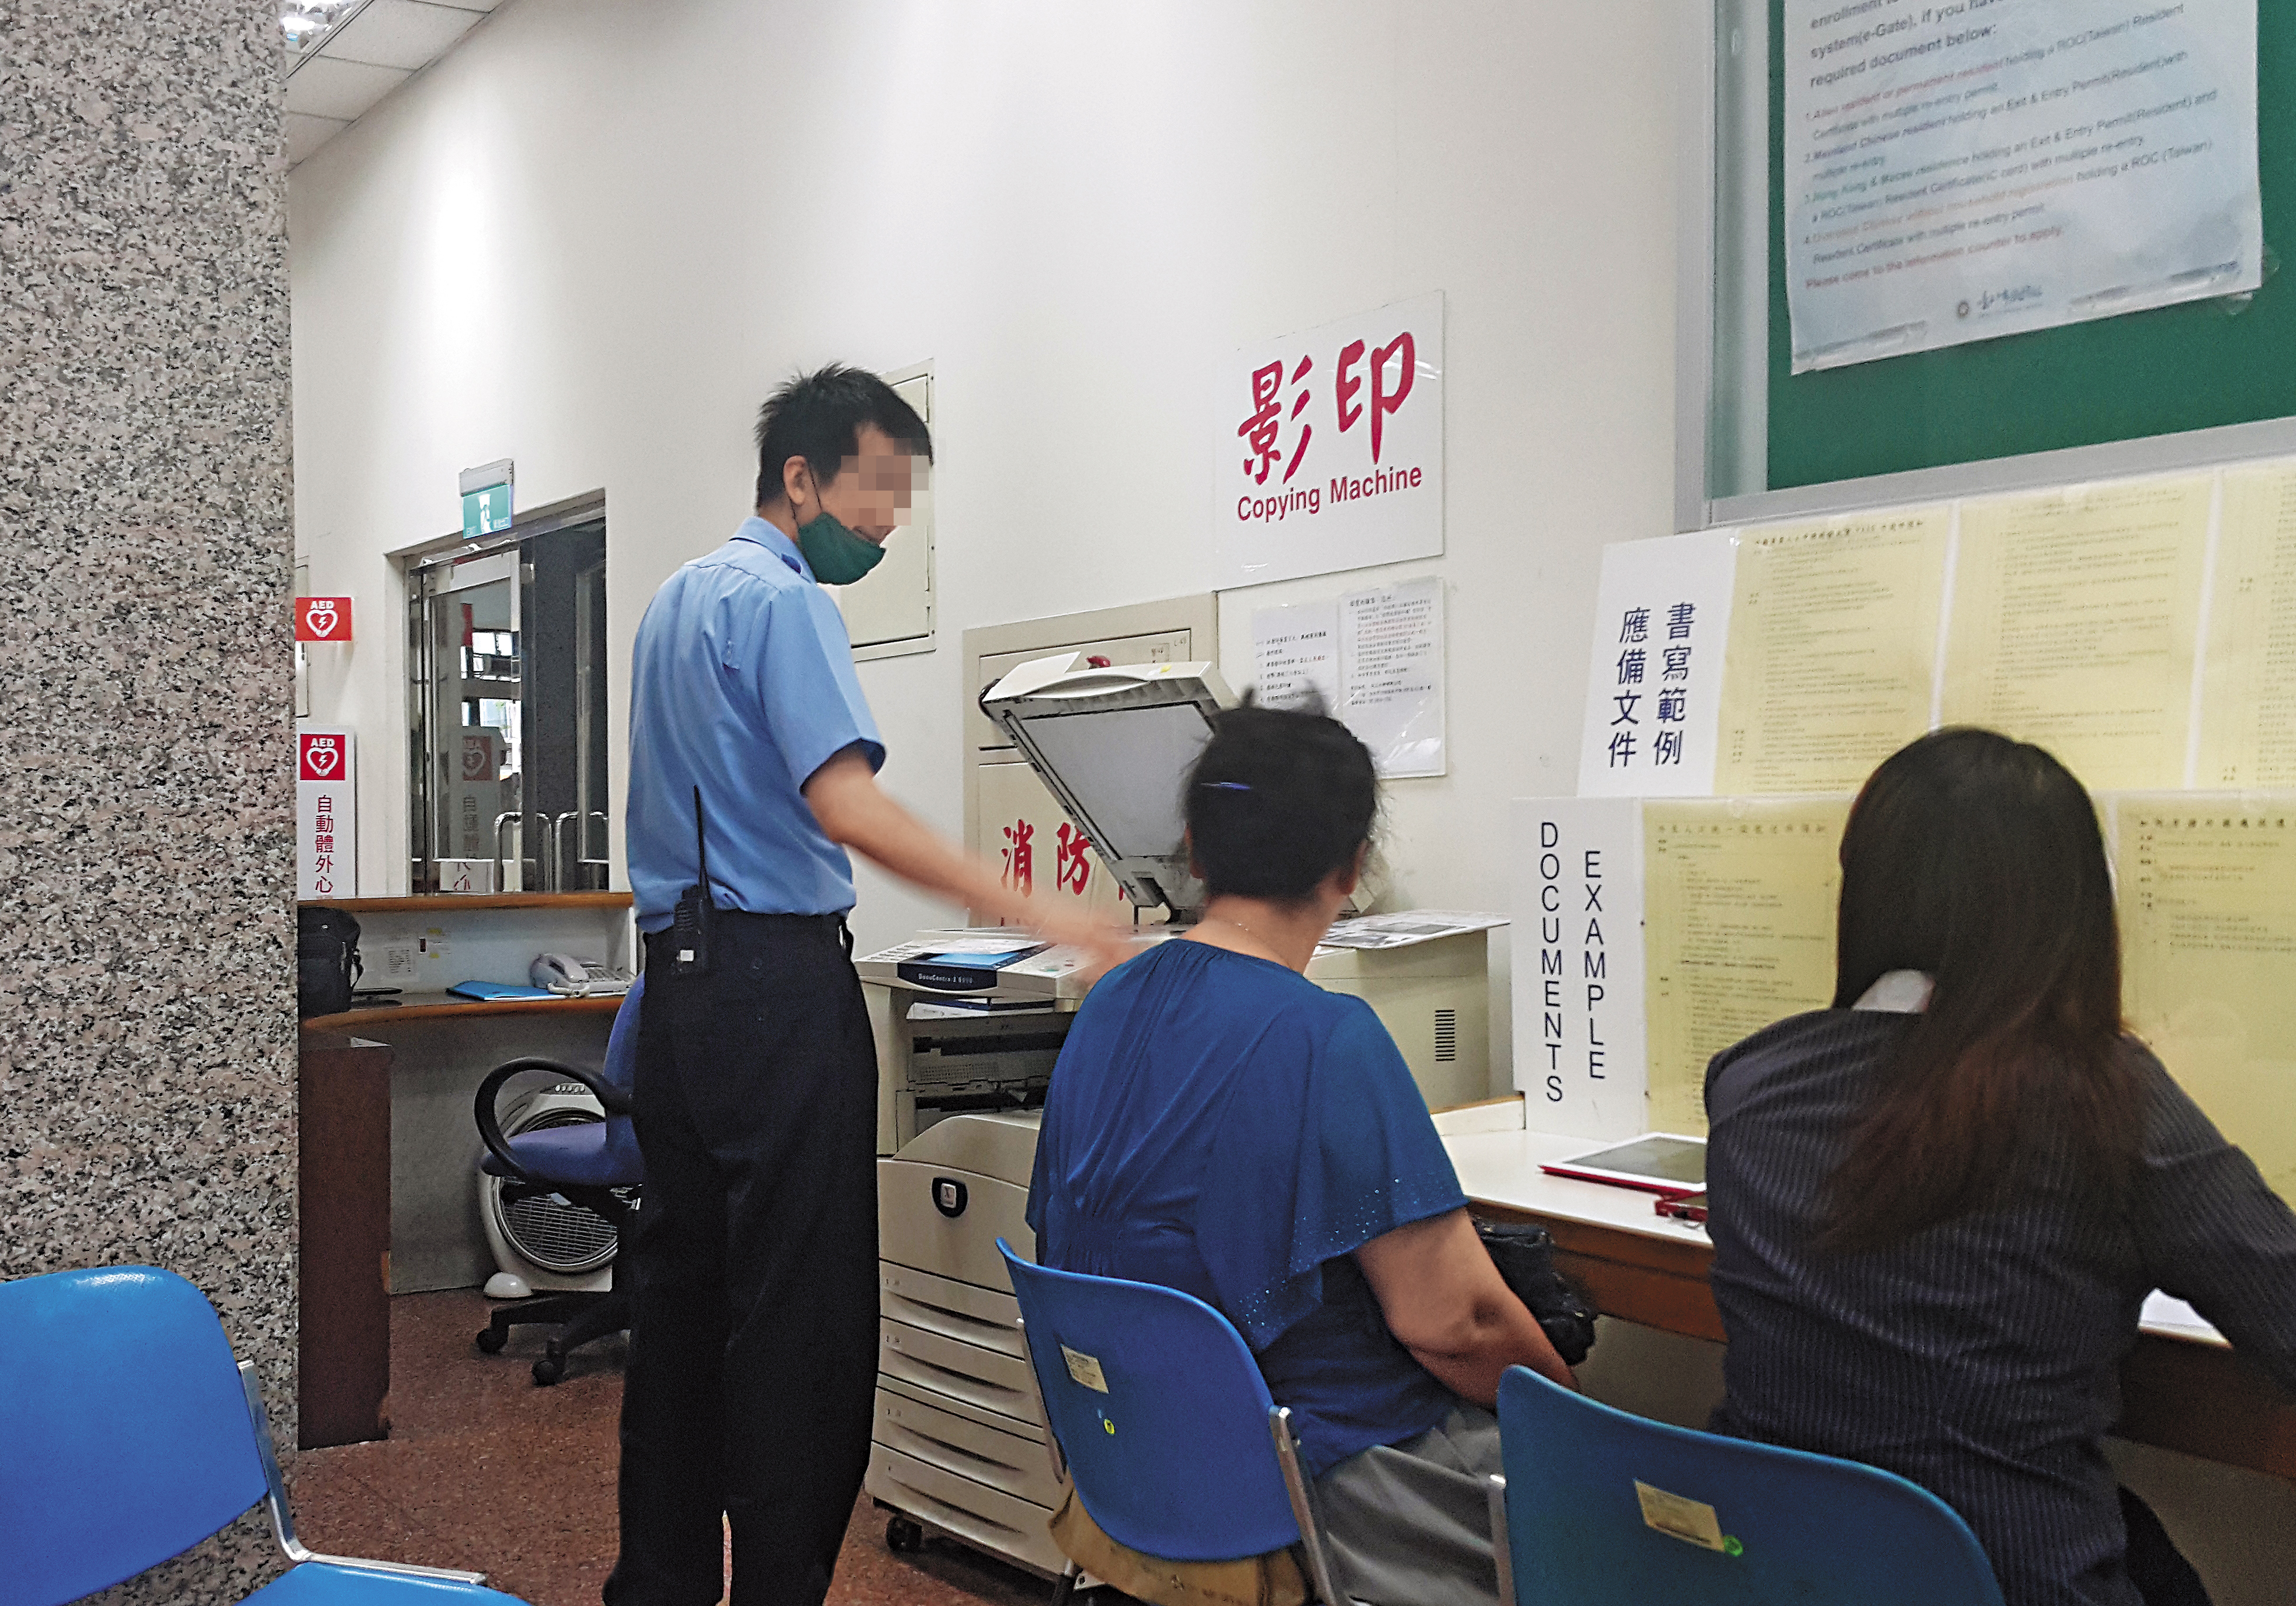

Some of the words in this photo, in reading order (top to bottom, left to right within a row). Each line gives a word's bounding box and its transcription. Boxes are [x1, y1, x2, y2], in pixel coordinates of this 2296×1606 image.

[1935, 3, 1964, 24] you
[1811, 59, 1866, 88] required
[1870, 39, 1941, 69] document
[1946, 24, 1997, 47] below:
[2065, 126, 2094, 140] Entry
[2131, 151, 2159, 169] ROC
[1238, 331, 1415, 485] 影印
[1238, 486, 1321, 523] Copying
[1330, 465, 1422, 503] Machine
[310, 600, 335, 610] AED
[1608, 607, 1651, 768] 應備文件
[1653, 602, 1697, 766] 書寫範例
[310, 738, 335, 747] AED
[315, 794, 334, 893] 自動體外心
[1001, 818, 1124, 901] 消防
[1540, 822, 1563, 1103] DOCUMENTS
[1585, 850, 1606, 1079] EXAMPLE
